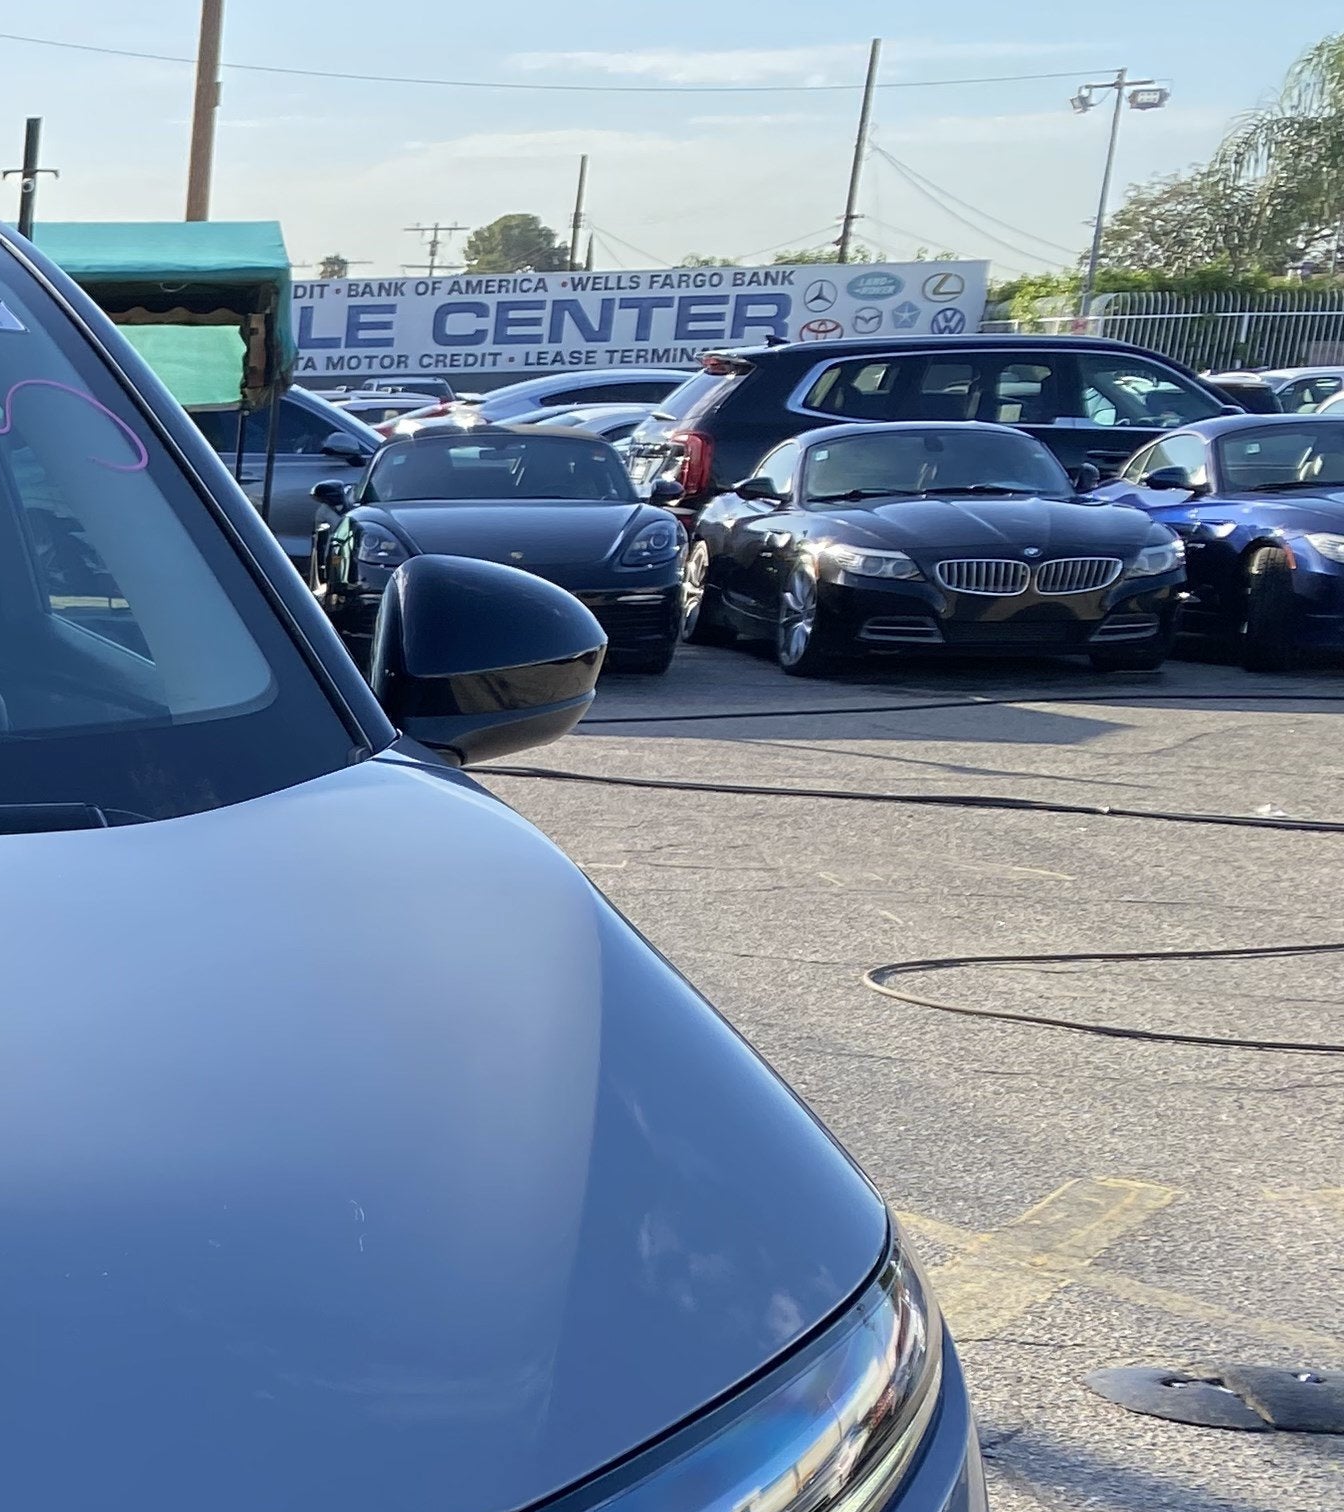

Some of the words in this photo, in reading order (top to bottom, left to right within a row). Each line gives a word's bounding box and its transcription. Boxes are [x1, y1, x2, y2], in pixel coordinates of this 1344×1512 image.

[346, 281, 408, 298] BANK
[414, 280, 443, 297] OF
[446, 277, 549, 296] AMERICA
[570, 274, 642, 293] WELLS
[648, 272, 725, 291] FARGO
[731, 270, 796, 288] BANK
[432, 293, 793, 347] CENTER
[325, 354, 410, 372] MOTOR
[418, 351, 503, 369] CREDIT
[524, 349, 598, 367] LEASE
[605, 347, 700, 366] TERMIN
